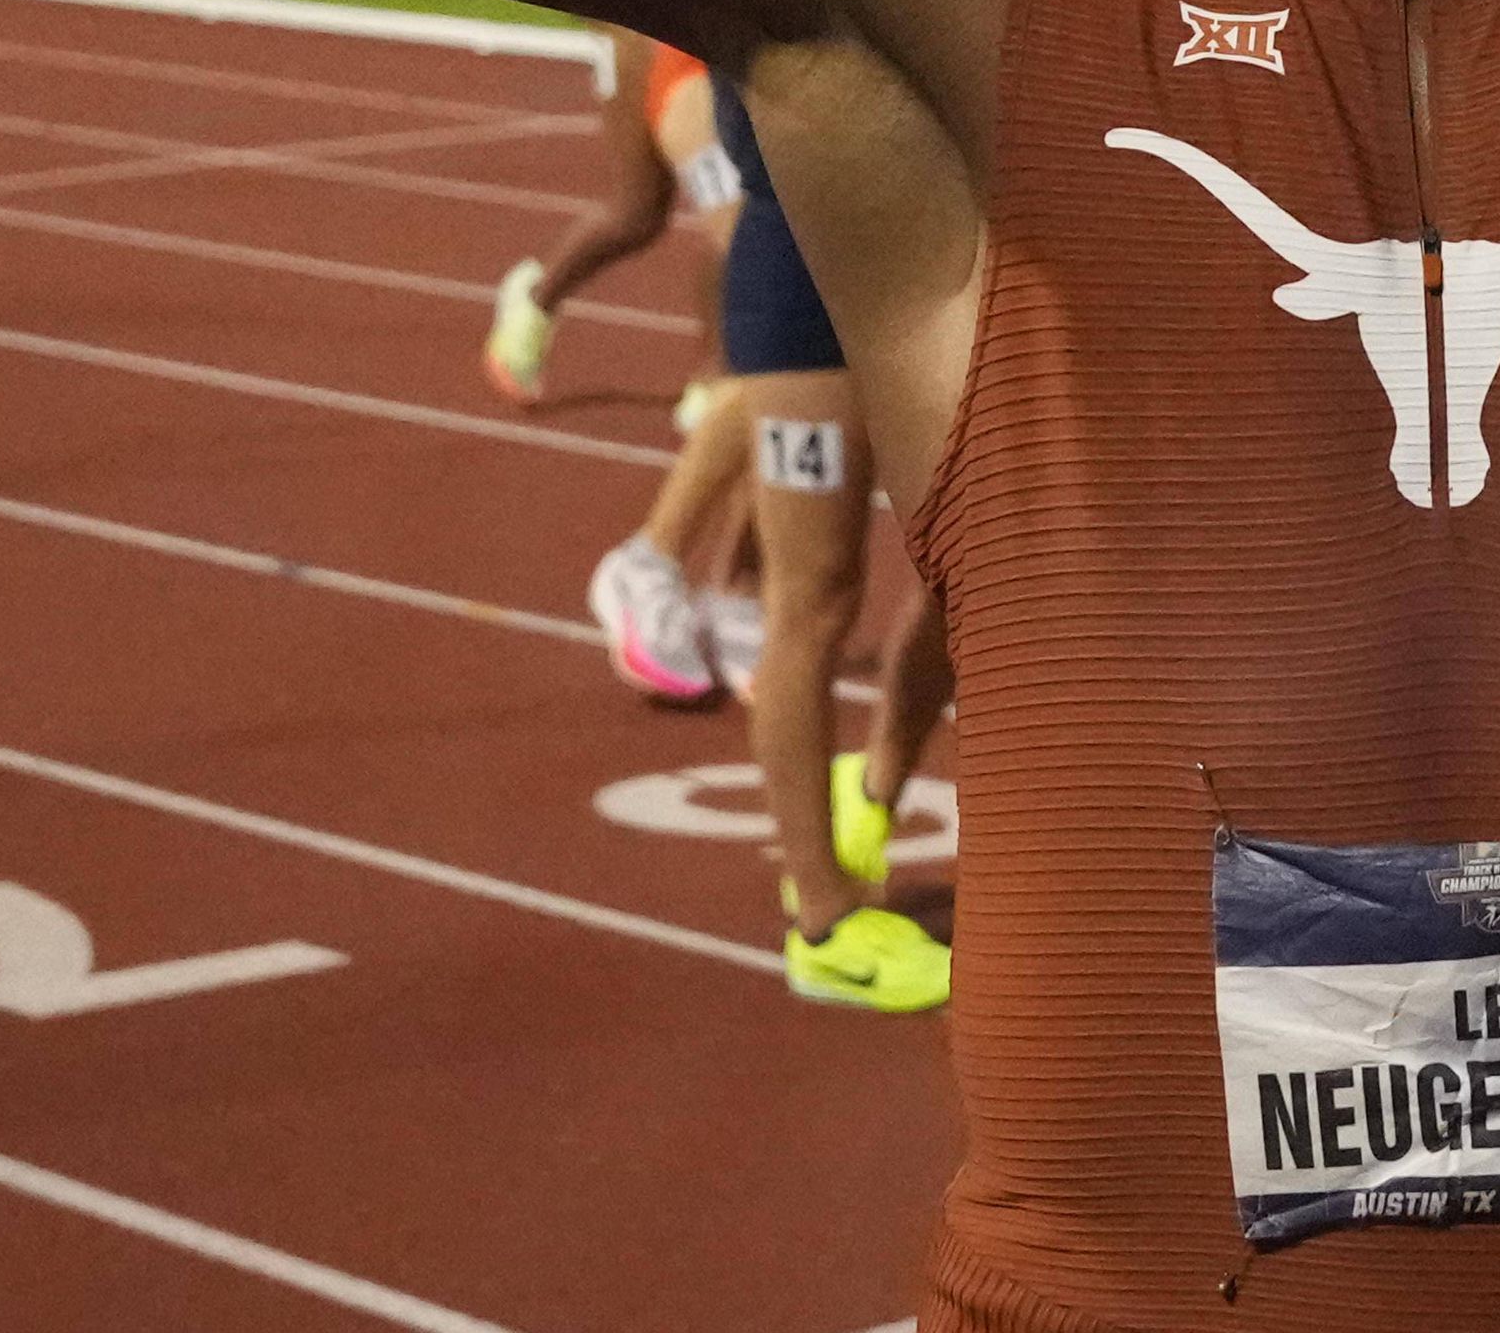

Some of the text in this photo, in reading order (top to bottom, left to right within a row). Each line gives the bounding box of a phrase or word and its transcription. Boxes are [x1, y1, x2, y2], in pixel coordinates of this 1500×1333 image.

[763, 429, 826, 480] 14
[1464, 865, 1492, 876] TRACK
[1352, 1191, 1448, 1218] AUSTIN
[1463, 1190, 1496, 1212] TX
